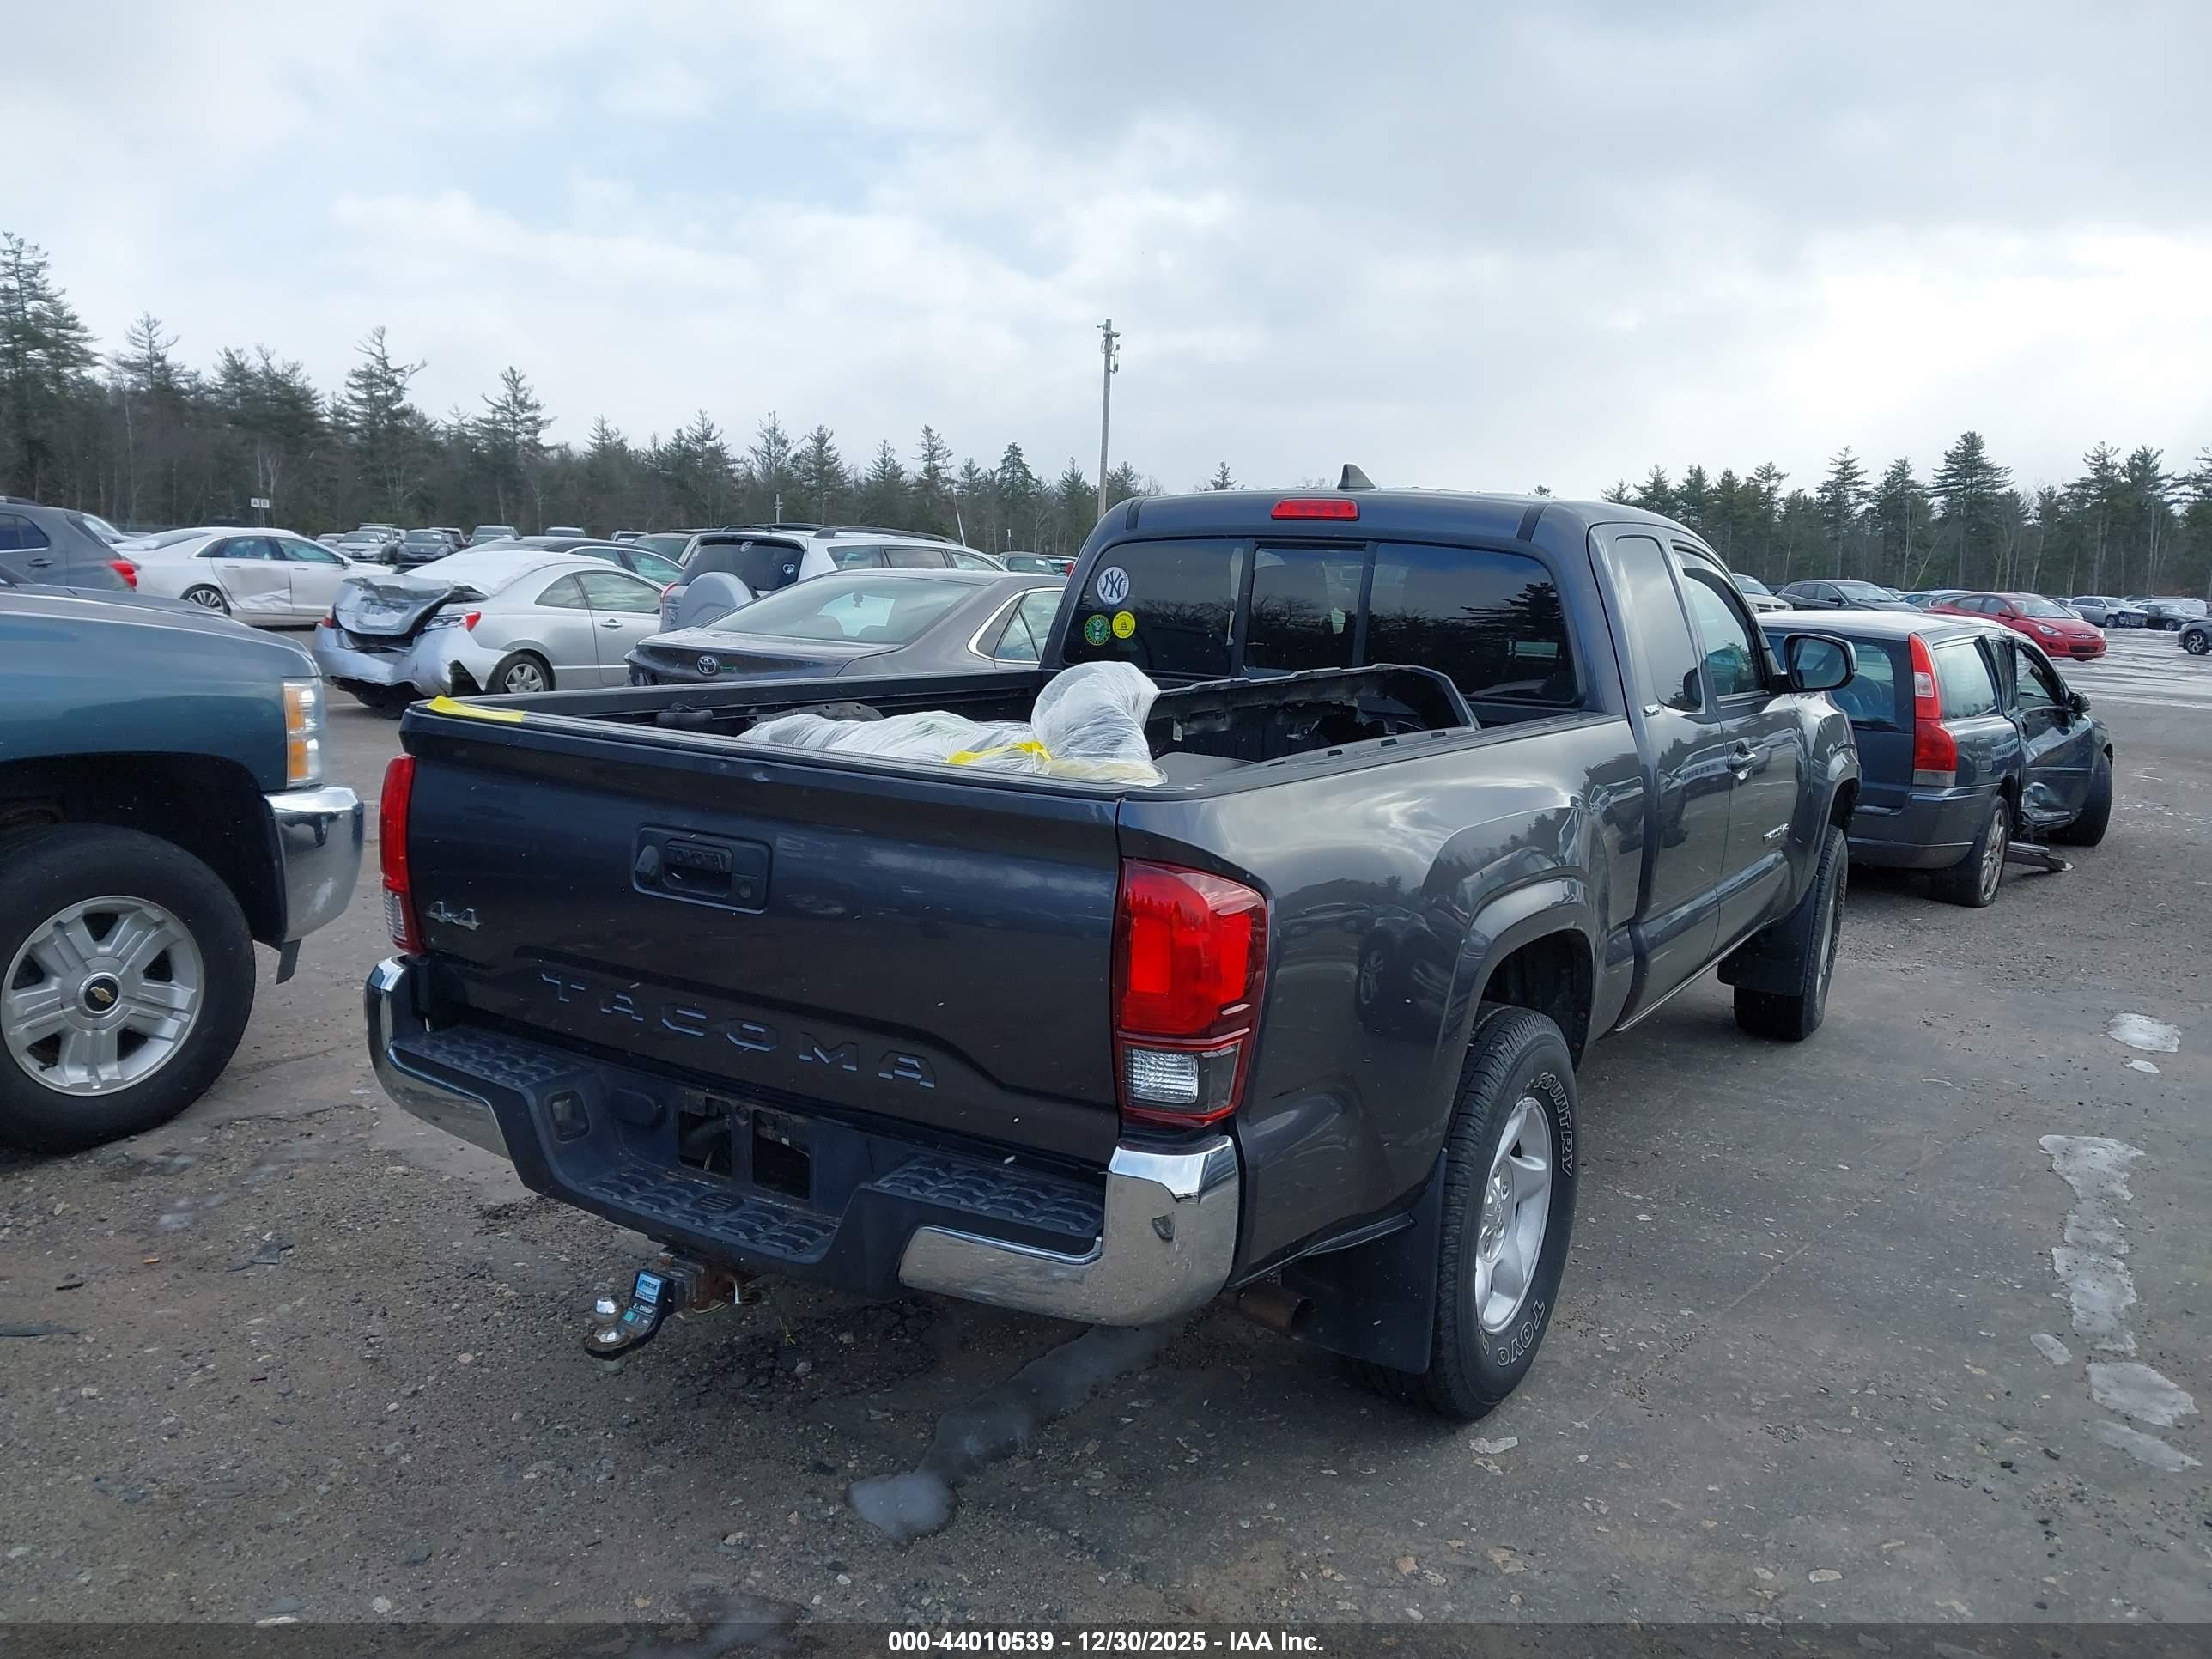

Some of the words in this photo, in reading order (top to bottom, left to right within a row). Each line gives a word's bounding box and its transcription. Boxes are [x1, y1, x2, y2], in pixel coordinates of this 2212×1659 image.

[1101, 570, 1125, 599] NY
[539, 972, 938, 1089] TACOMA
[1534, 1072, 1574, 1177] COUNTRY
[1497, 1300, 1546, 1366] TOYO
